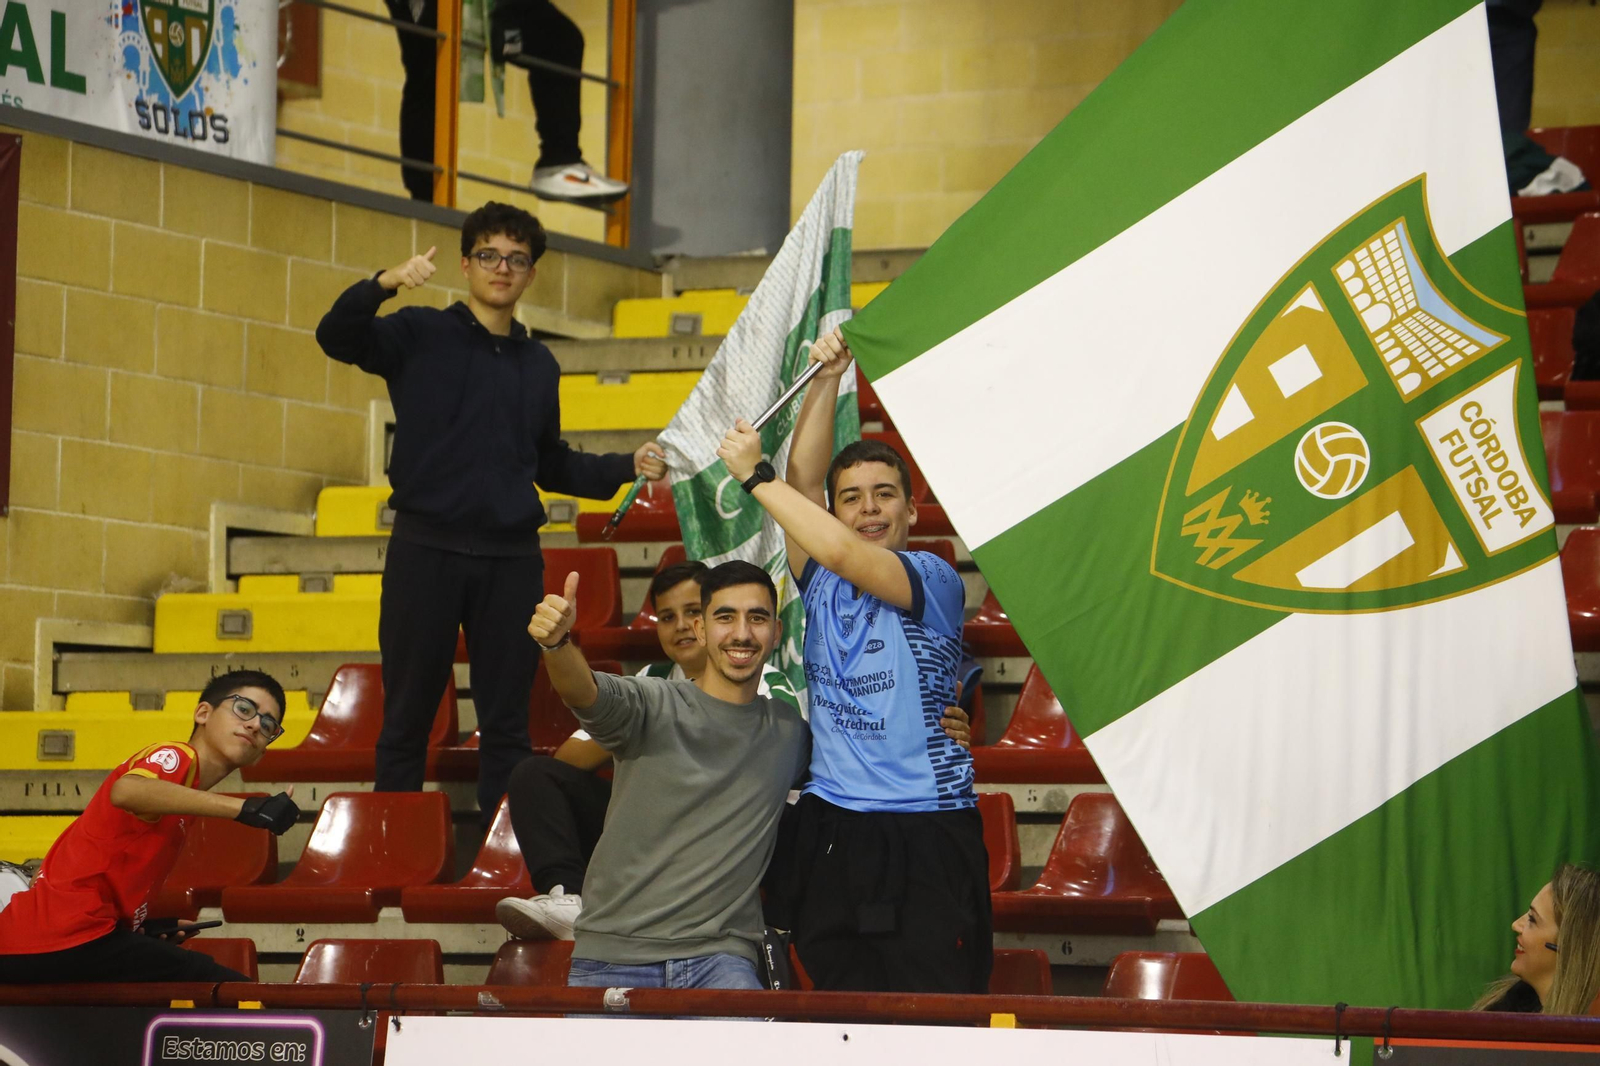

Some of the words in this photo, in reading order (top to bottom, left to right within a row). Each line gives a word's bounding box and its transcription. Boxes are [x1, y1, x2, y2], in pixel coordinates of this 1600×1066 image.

[135, 99, 229, 143] SOLOS
[1439, 428, 1502, 530] FUTSAL
[1460, 401, 1537, 529] CÓRDOBA
[1062, 941, 1072, 955] 6
[162, 1036, 265, 1060] Estamos
[270, 1042, 306, 1062] en:
